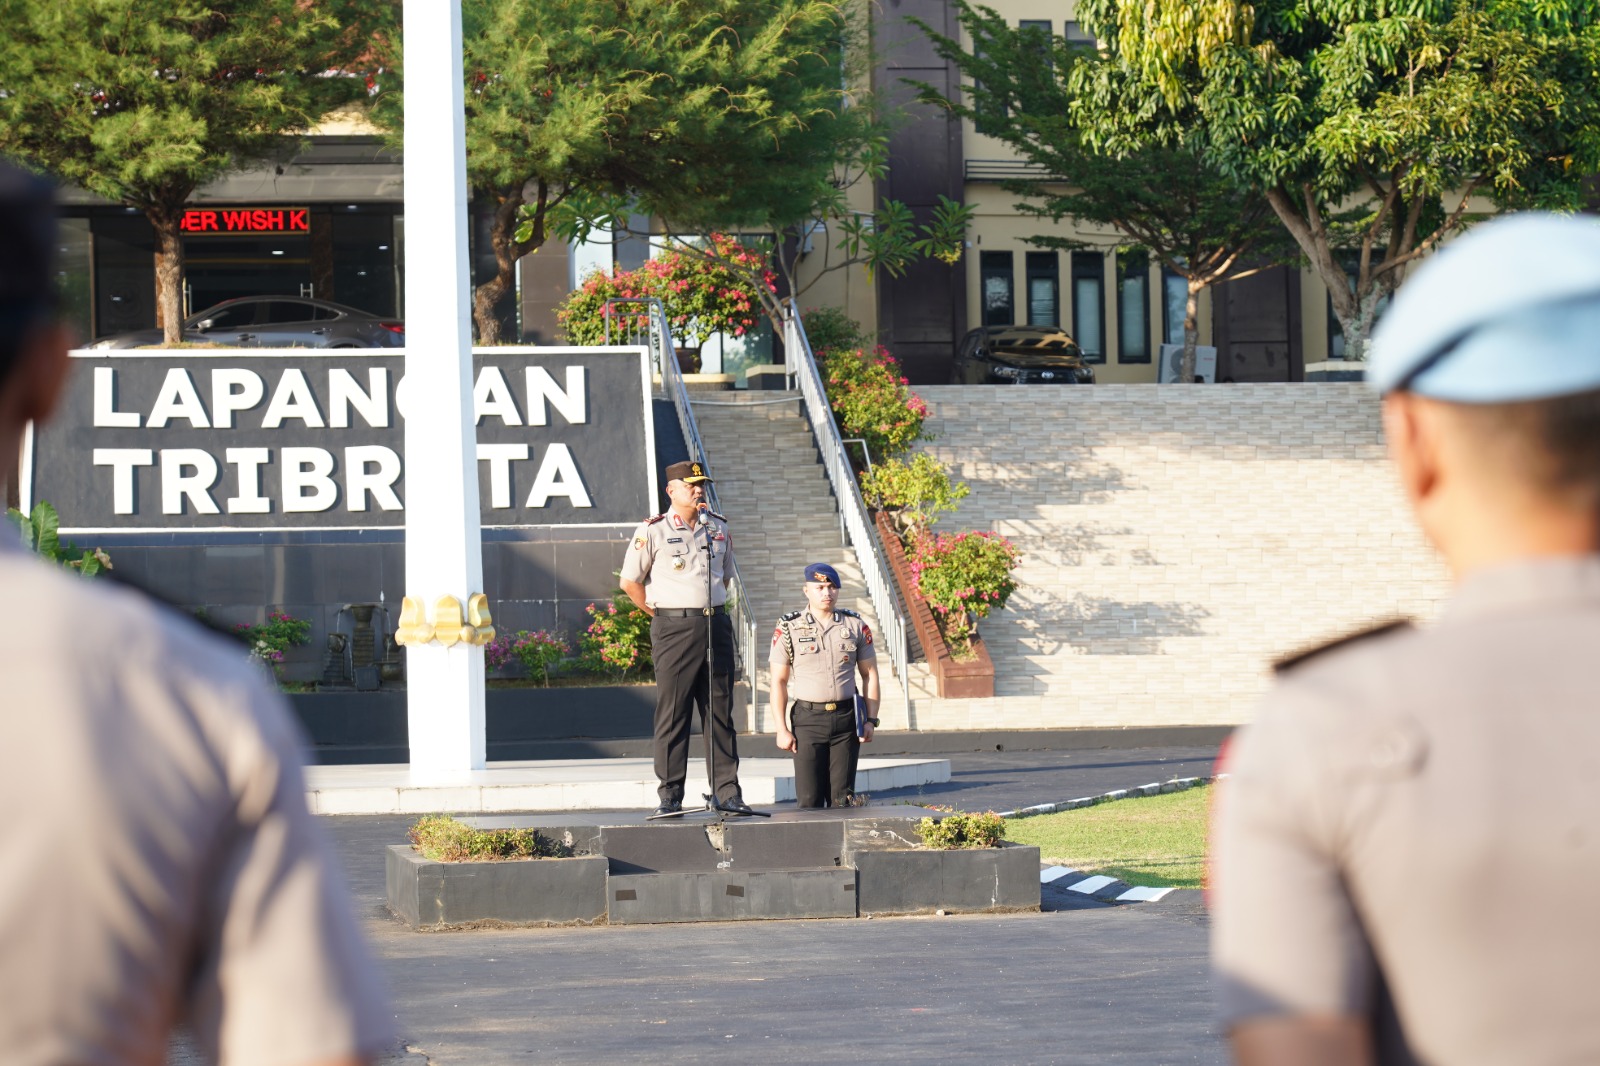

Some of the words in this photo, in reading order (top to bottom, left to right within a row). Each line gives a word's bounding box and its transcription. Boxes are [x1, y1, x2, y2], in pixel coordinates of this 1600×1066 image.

[222, 209, 284, 231] WISH
[290, 209, 308, 230] K
[93, 365, 586, 429] LAPANAN
[93, 443, 592, 515] TRIBRTA
